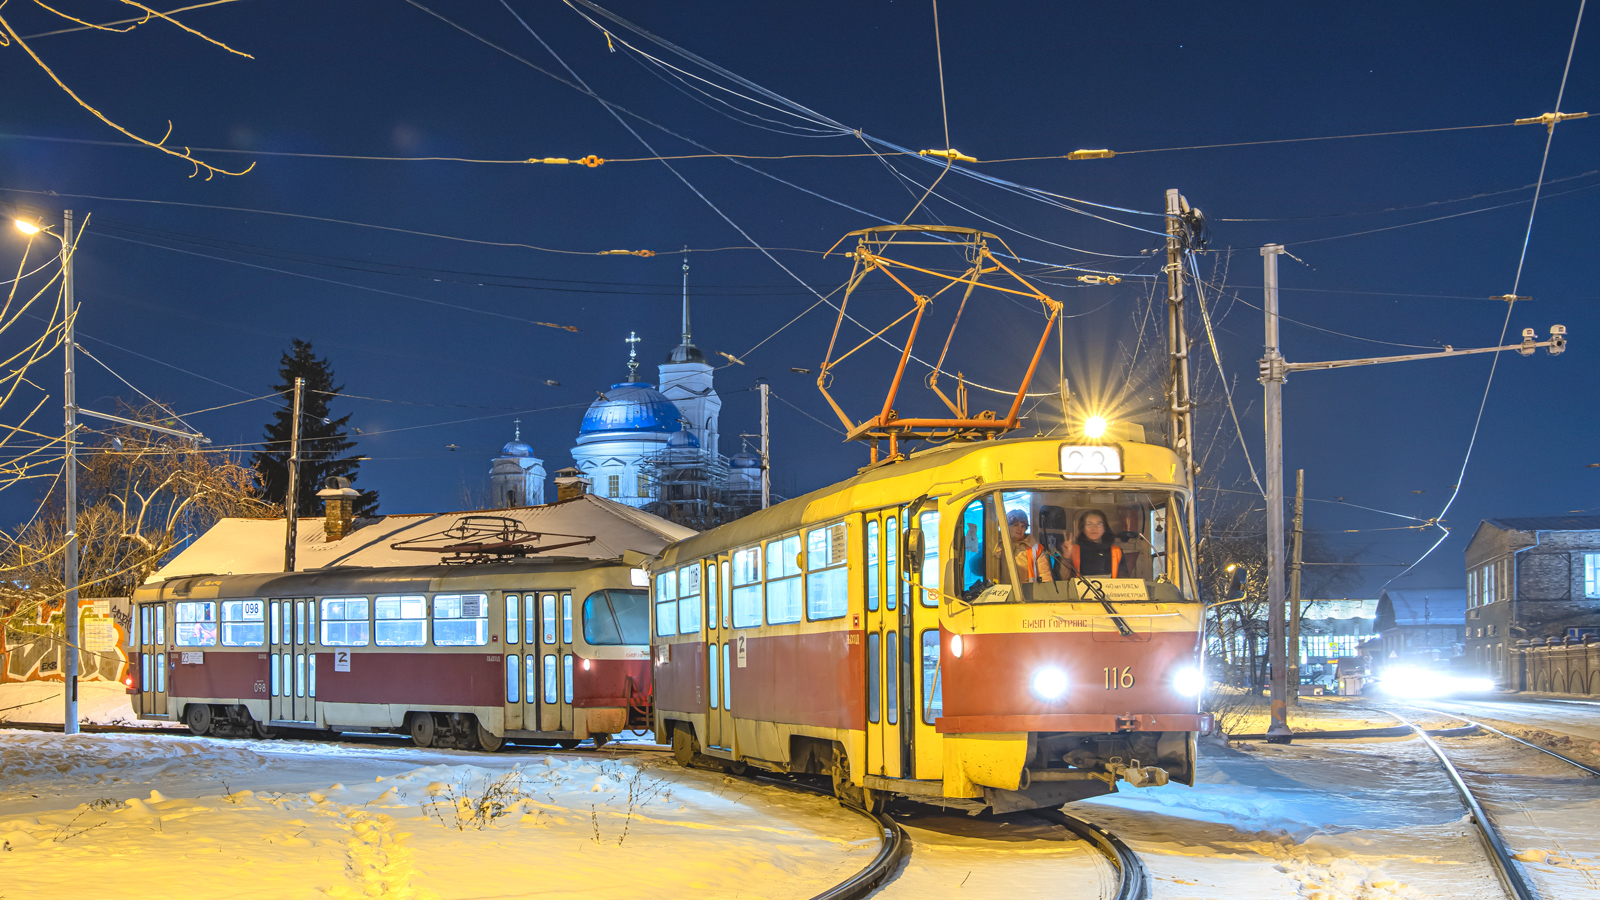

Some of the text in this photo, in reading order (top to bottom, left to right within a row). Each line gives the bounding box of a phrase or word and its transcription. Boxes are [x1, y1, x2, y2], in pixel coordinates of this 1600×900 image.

[1068, 450, 1108, 474] 23
[1077, 580, 1105, 600] 23
[244, 603, 259, 614] 098
[1022, 619, 1046, 629] ЕМУП
[1103, 666, 1136, 690] 116
[253, 682, 267, 693] 098
